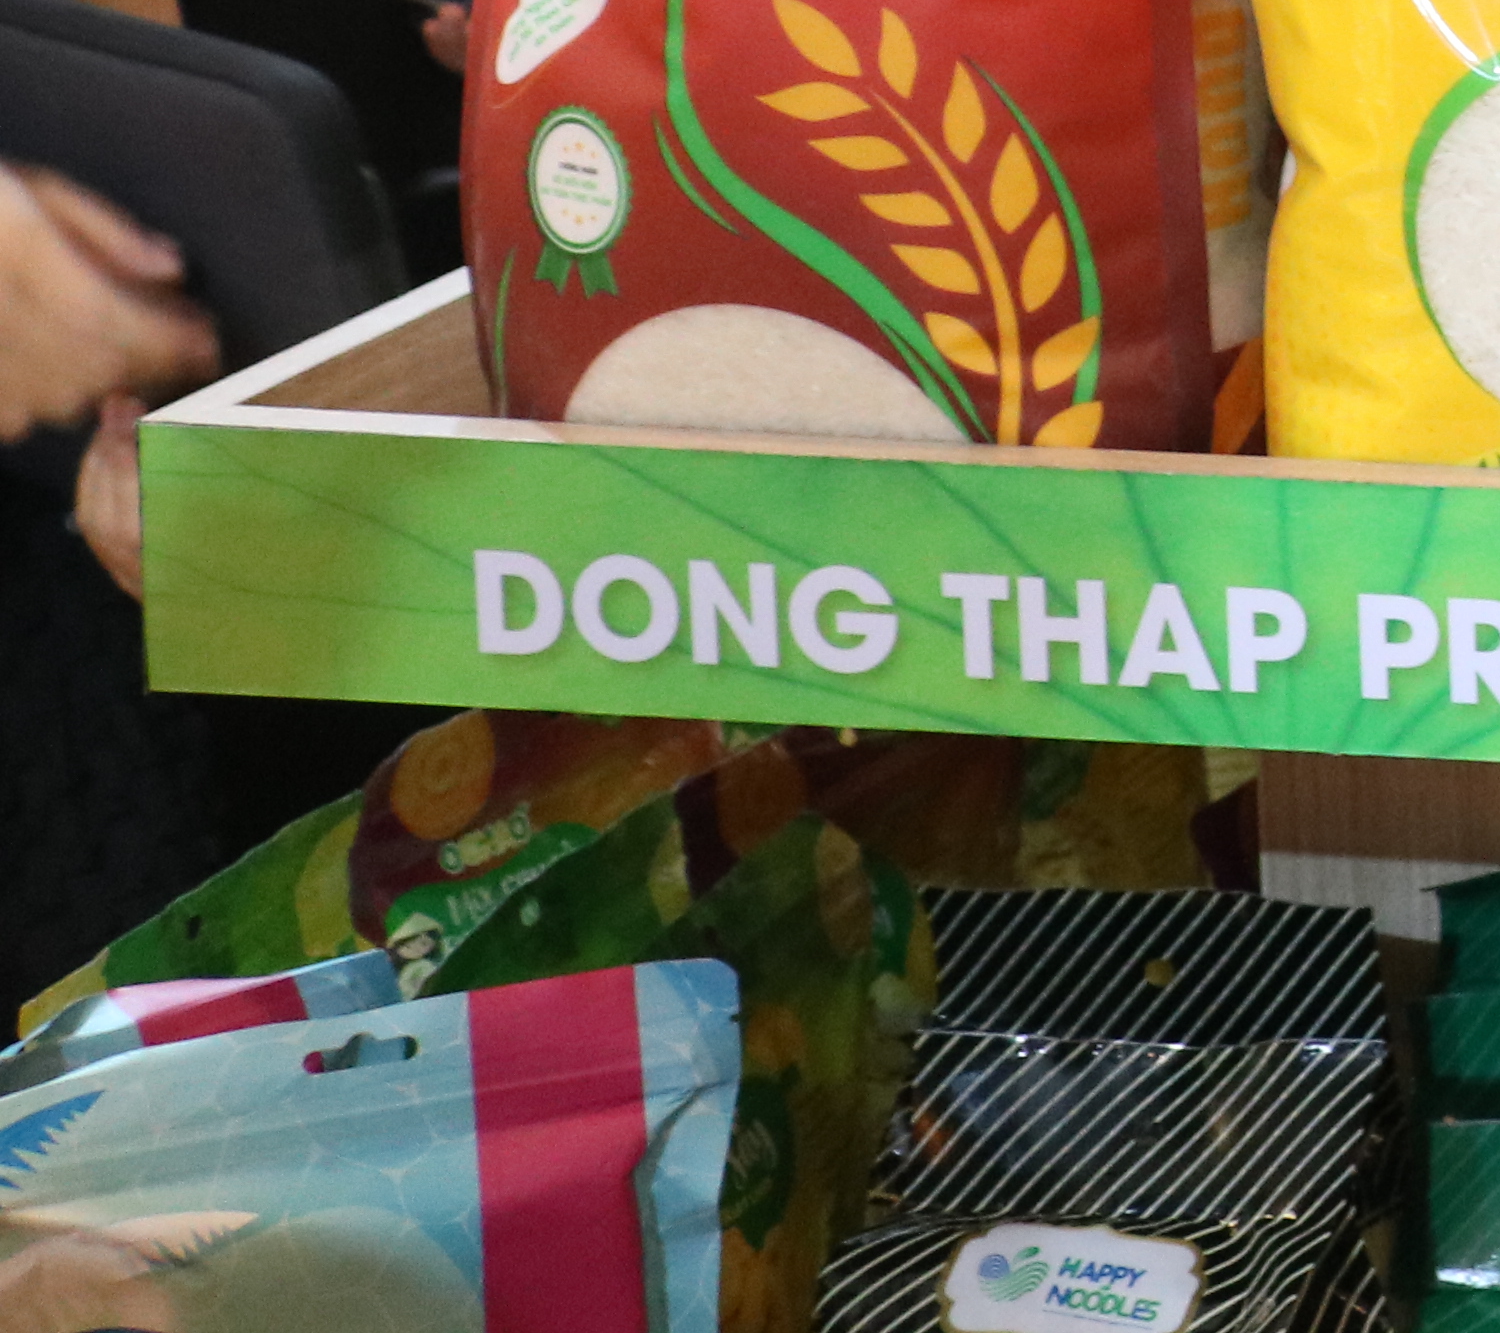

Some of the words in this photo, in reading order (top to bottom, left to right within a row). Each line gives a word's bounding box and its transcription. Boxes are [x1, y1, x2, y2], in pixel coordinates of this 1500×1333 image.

[472, 547, 900, 676] DONG
[938, 570, 1310, 695] THAP
[1057, 1255, 1149, 1288] HAPPY
